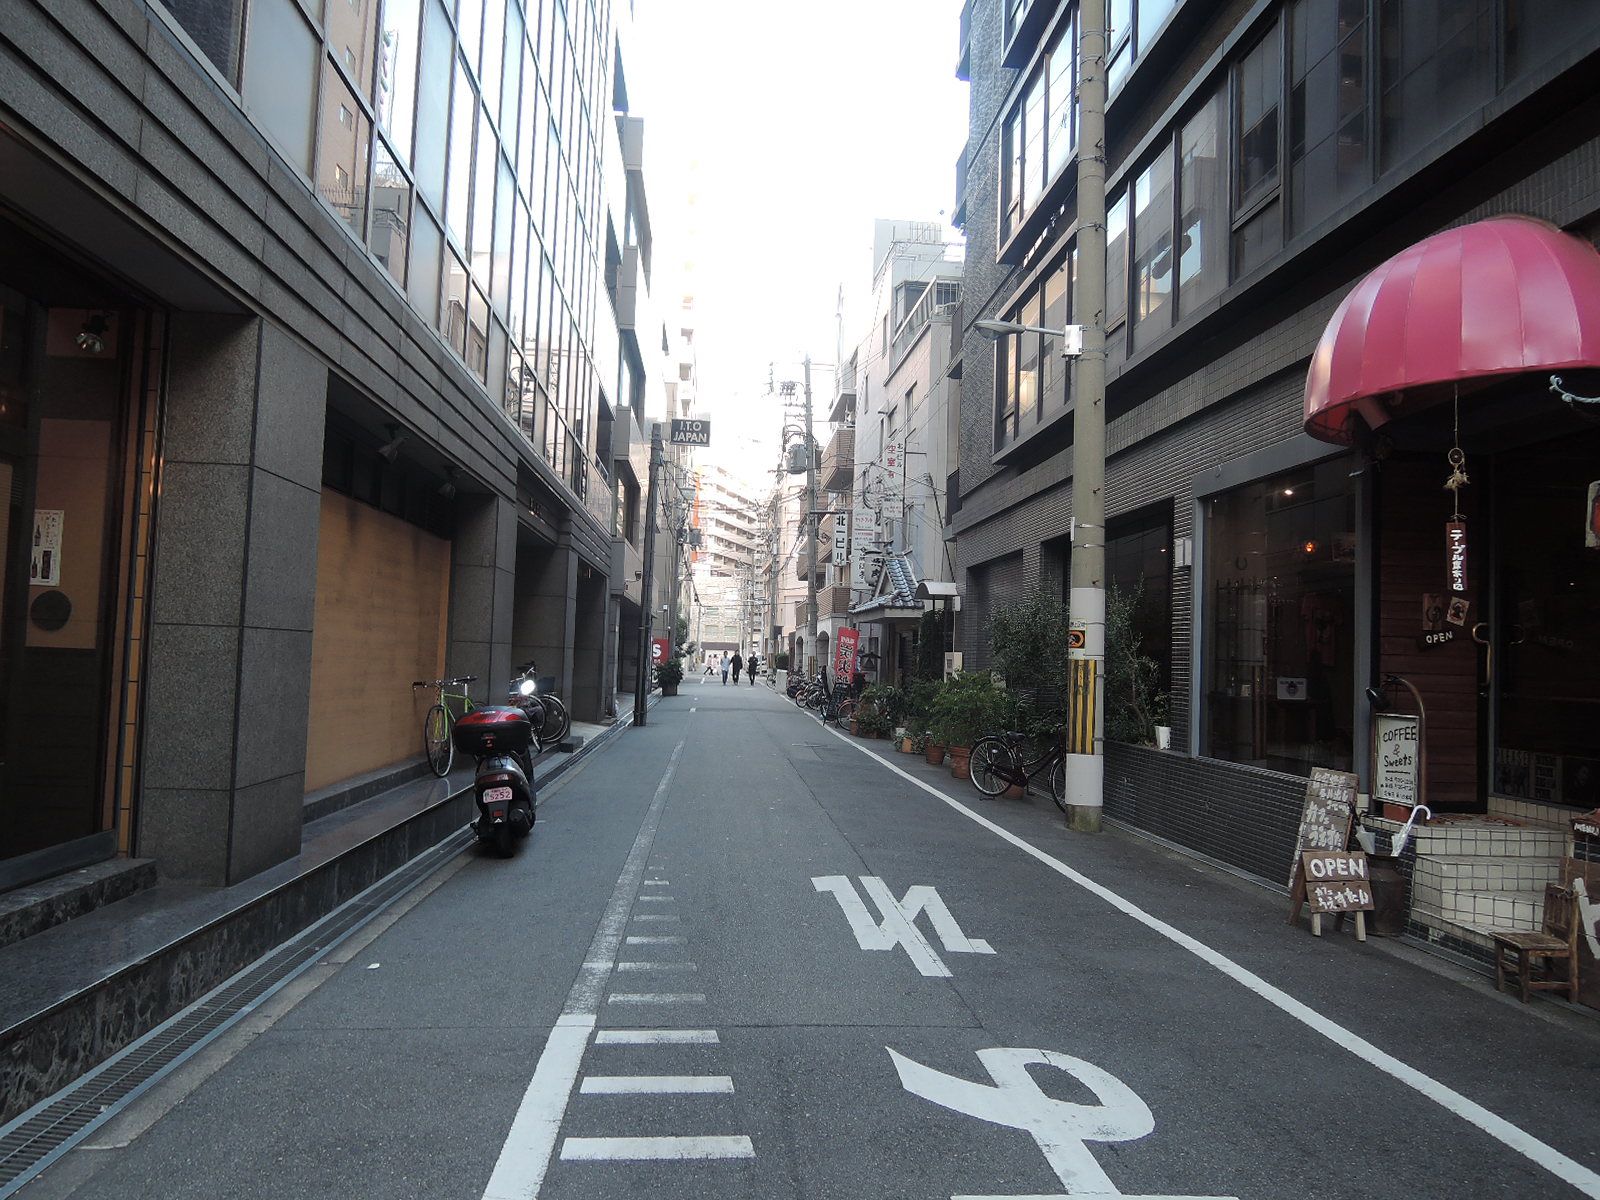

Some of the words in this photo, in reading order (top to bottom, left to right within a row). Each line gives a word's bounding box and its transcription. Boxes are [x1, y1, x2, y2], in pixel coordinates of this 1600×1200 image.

[673, 431, 707, 443] JAPAN
[835, 515, 846, 565] 北一ビル
[1425, 630, 1454, 644] OPEN
[1382, 725, 1418, 742] COFFEE
[1392, 743, 1401, 757] &
[1384, 753, 1412, 767] Sweets
[1310, 856, 1365, 879] OPEN
